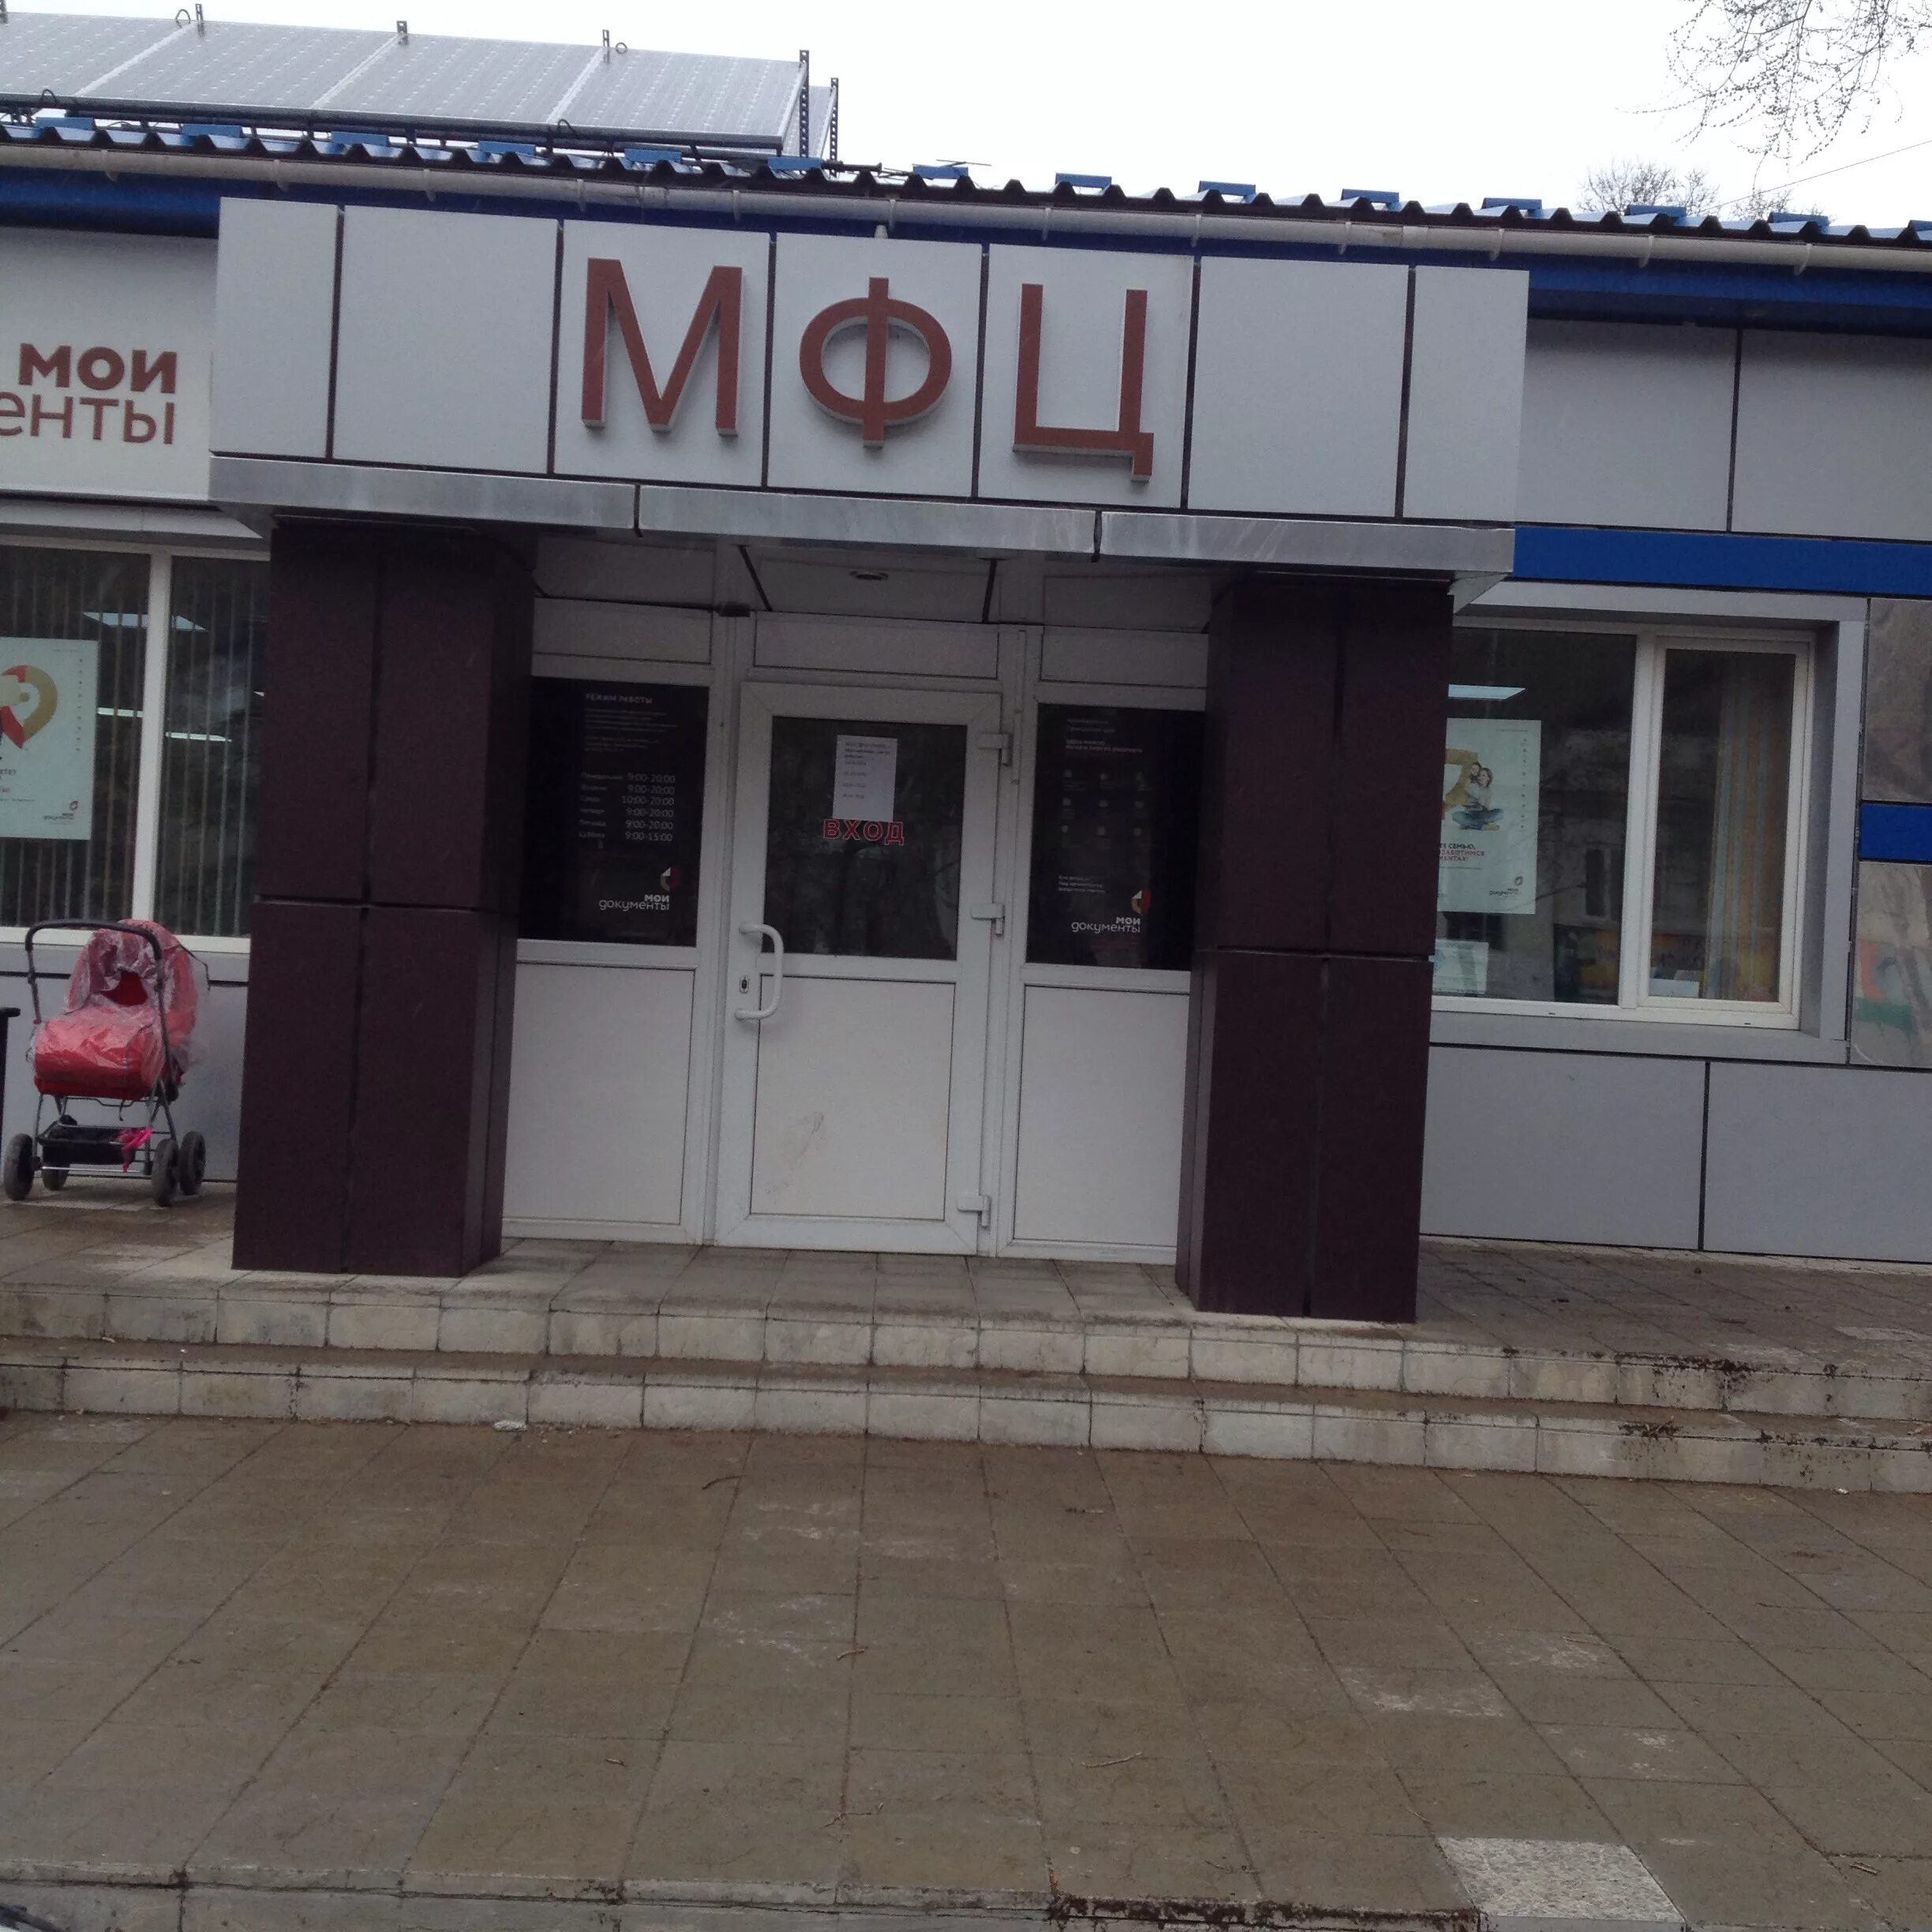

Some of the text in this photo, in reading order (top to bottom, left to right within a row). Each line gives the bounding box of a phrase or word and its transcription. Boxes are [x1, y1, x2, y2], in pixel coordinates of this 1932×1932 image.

[580, 256, 1155, 482] МФЦ
[822, 818, 905, 846] ВХОД
[598, 899, 669, 912] документы
[1071, 922, 1140, 934] документы
